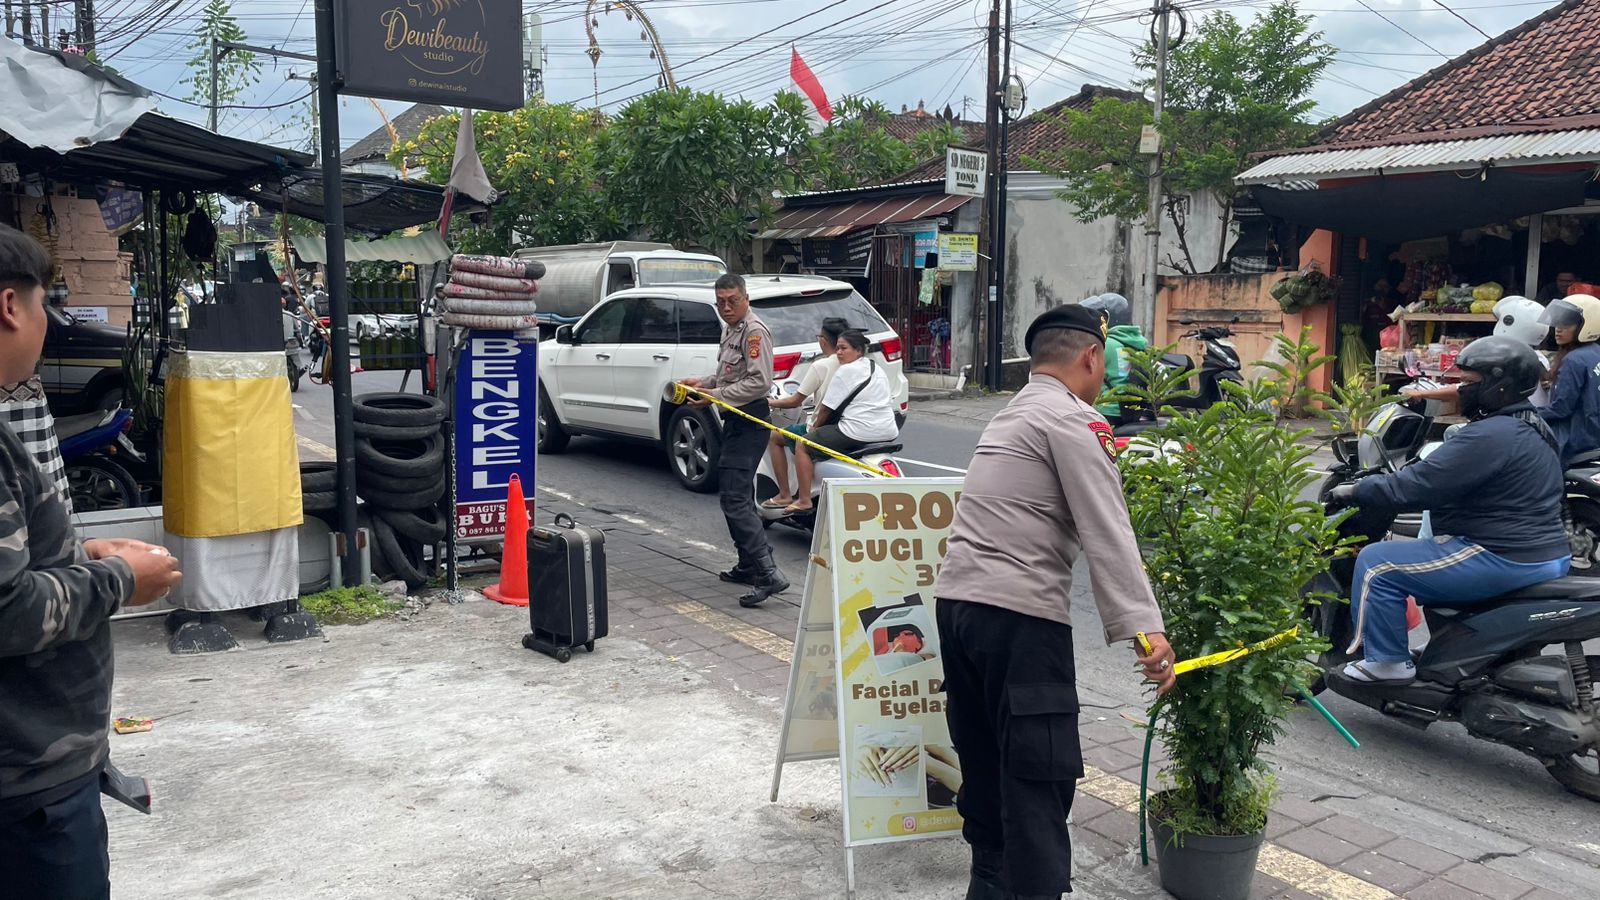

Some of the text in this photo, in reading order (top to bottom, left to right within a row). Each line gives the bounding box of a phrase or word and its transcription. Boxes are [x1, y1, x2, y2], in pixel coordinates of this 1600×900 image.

[380, 7, 490, 76] Dewibeauty
[423, 51, 453, 62] studio
[951, 152, 985, 171] SD NEGERI 3
[955, 171, 979, 183] TONJA
[471, 338, 521, 490] BENGKEL
[843, 538, 923, 563] CUCI
[916, 563, 942, 587] 3
[852, 679, 919, 700] Facial
